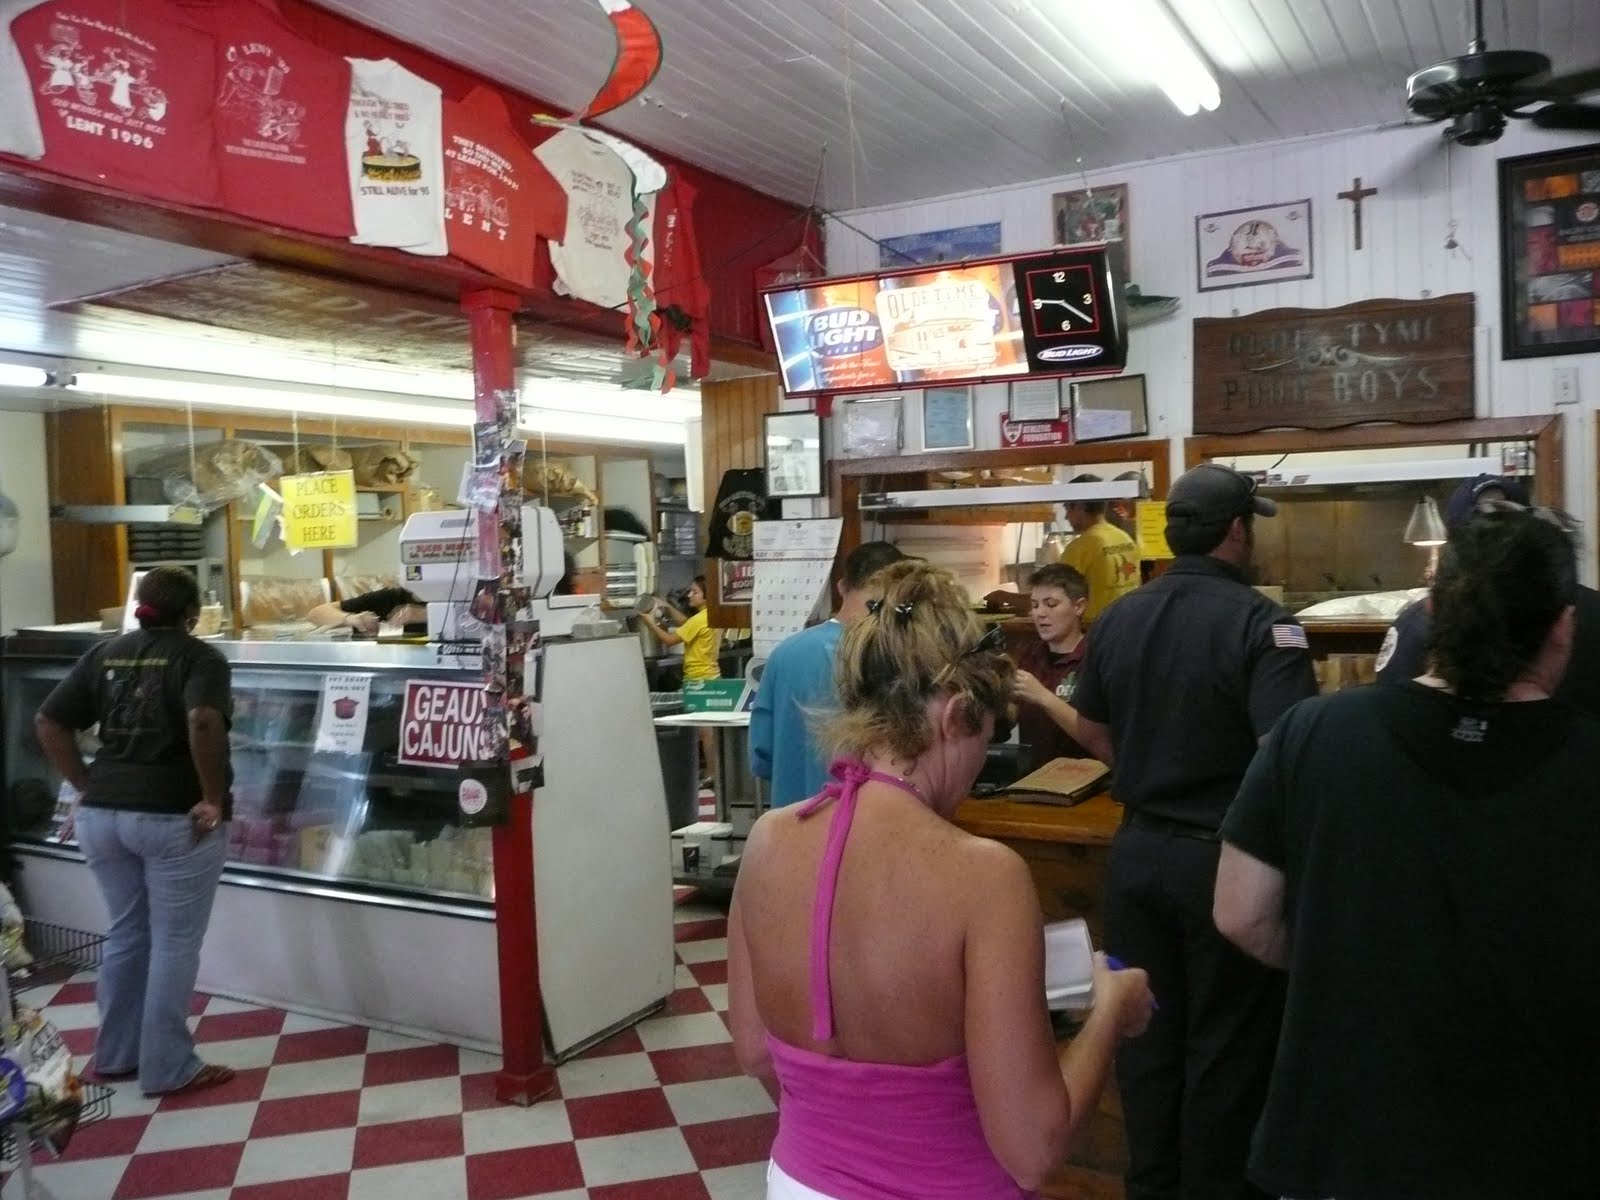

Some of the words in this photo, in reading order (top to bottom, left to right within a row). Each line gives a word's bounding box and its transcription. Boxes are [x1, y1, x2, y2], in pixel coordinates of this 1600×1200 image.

[66, 116, 106, 136] LENT
[110, 127, 155, 150] 1996
[360, 186, 384, 196] STILL
[1052, 271, 1066, 283] 12
[887, 290, 929, 319] OLDE
[1032, 298, 1043, 310] 9
[1082, 293, 1093, 305] 3
[813, 309, 870, 331] BUD
[1061, 320, 1071, 331] 6
[809, 325, 880, 349] LIGHT
[1042, 348, 1066, 358] BUD
[1066, 346, 1100, 357] LIGHT
[1333, 367, 1441, 402] BOYS
[295, 477, 339, 497] PLACE
[291, 501, 345, 520] ORDERS
[303, 524, 337, 543] HERE
